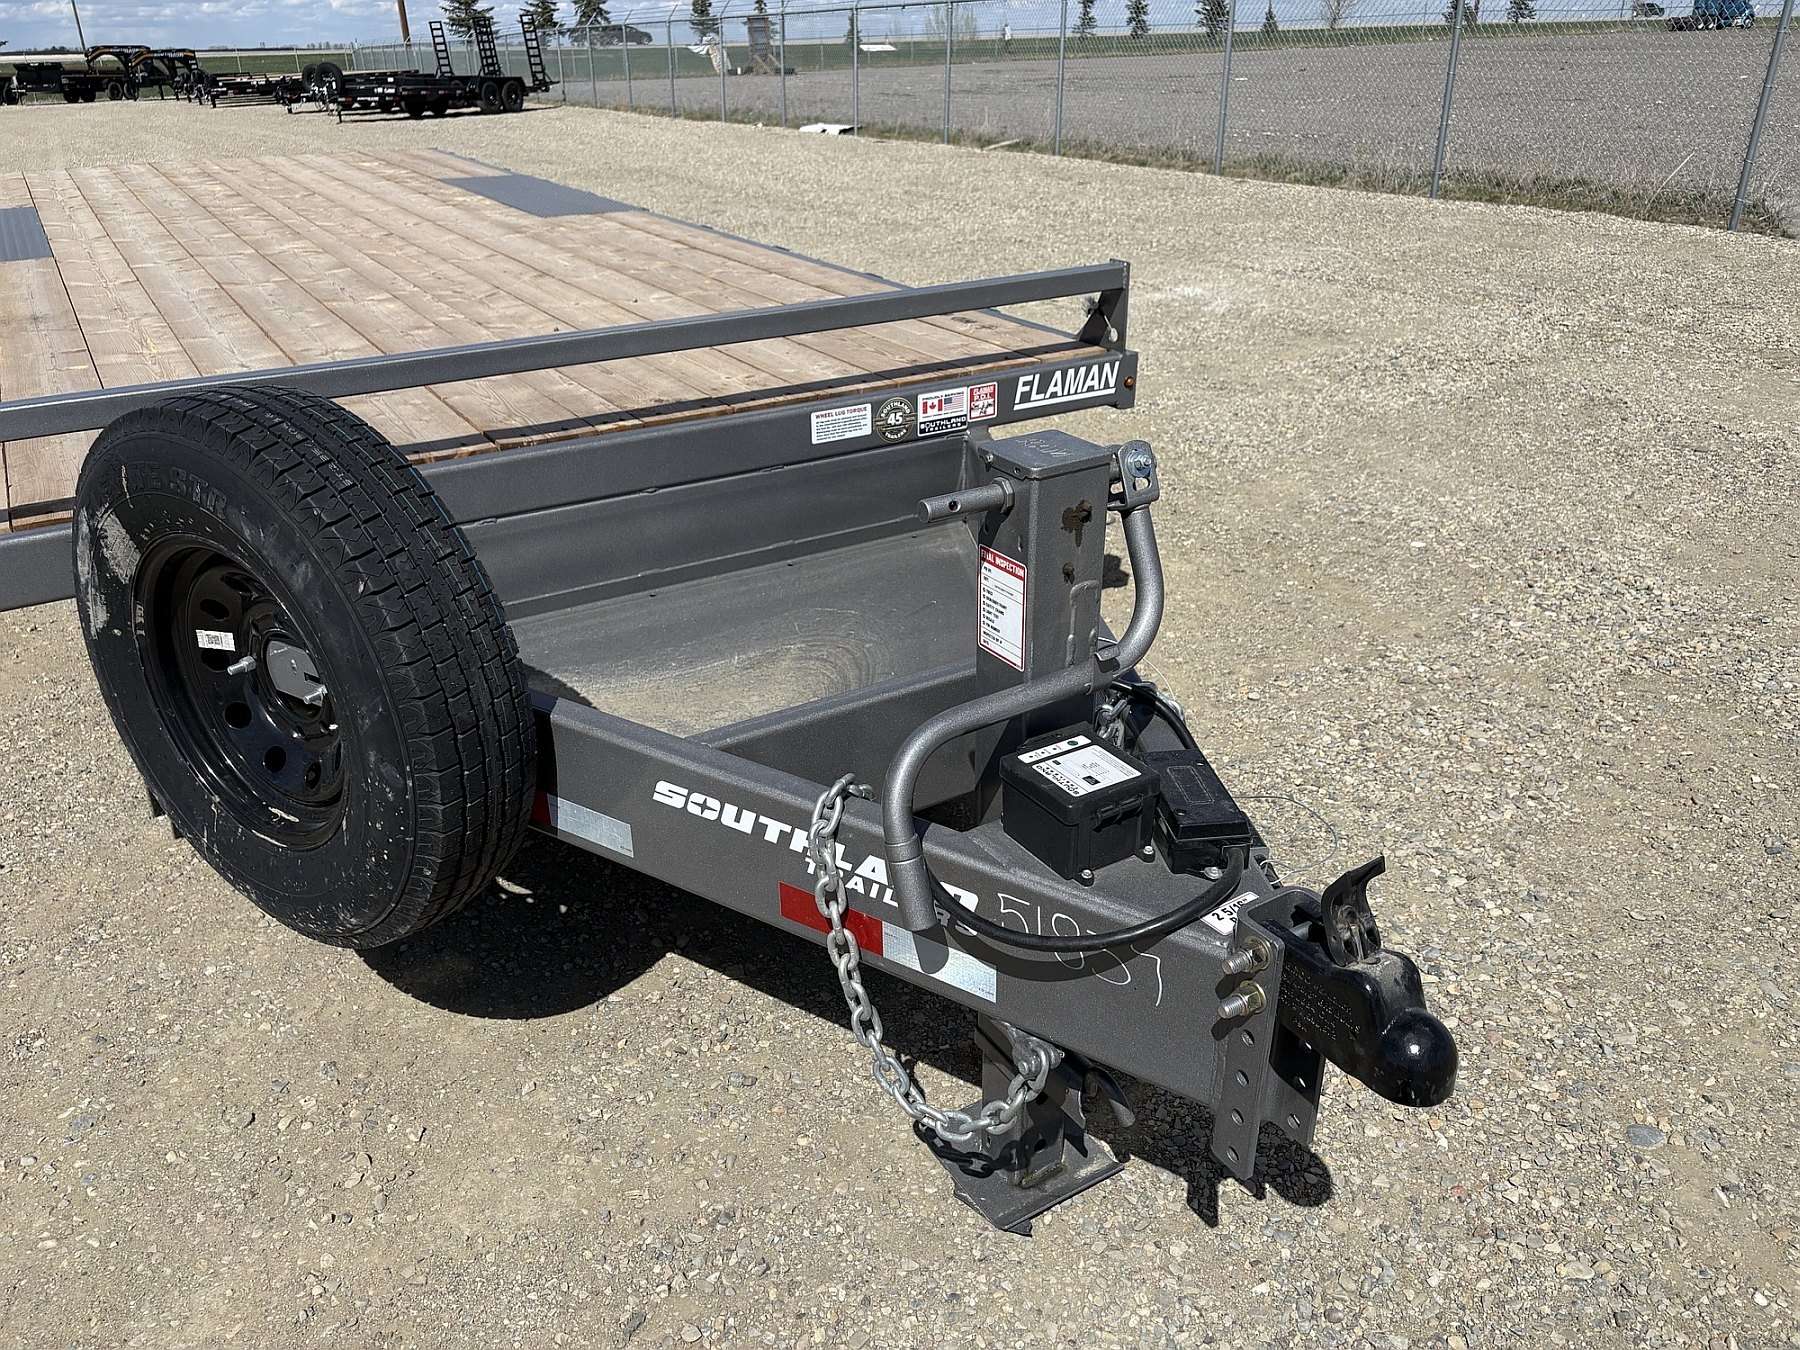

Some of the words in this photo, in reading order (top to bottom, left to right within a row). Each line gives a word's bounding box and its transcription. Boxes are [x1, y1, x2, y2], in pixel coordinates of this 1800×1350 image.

[1014, 361, 1120, 405] FLAMAN
[815, 411, 834, 420] WHEEL
[834, 409, 846, 417] LUG
[846, 406, 867, 415] TORQUE
[880, 401, 911, 418] SOUTHLAND
[887, 411, 904, 426] 45
[920, 416, 967, 430] SOUTHLAND
[884, 428, 907, 439] TRAILERS
[1035, 765, 1080, 795] SOUTHLAND
[652, 780, 979, 914] SOUTHLAD
[1211, 912, 1224, 921] 2
